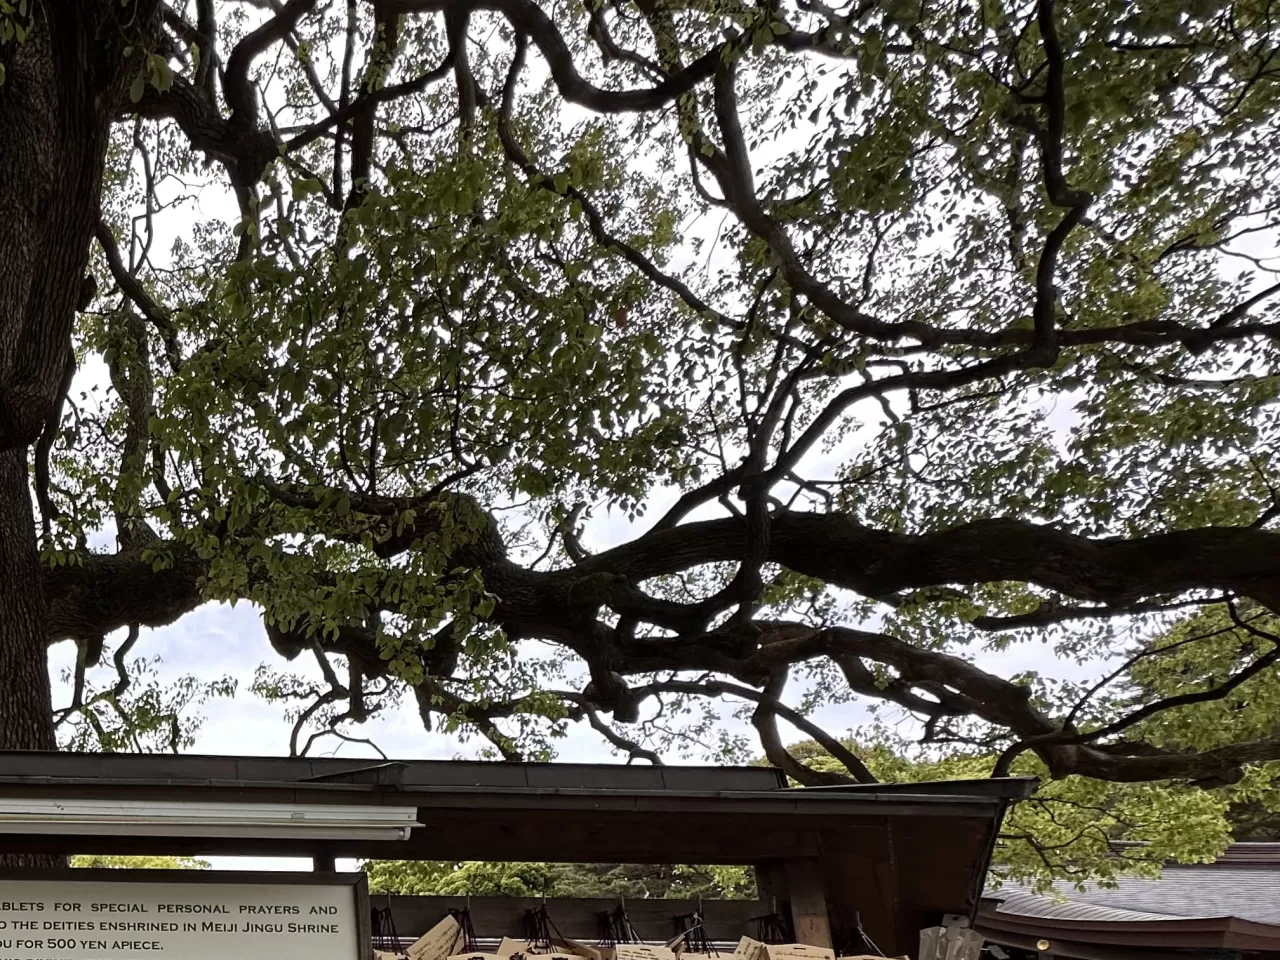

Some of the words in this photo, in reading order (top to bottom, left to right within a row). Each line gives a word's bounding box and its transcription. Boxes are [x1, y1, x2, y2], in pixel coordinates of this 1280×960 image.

[54, 902, 82, 912] FOR
[91, 903, 149, 913] SPECIAL
[157, 904, 230, 914] PERSONAL
[239, 905, 300, 915] PRAYERS
[309, 905, 338, 915] AND
[11, 920, 39, 930] THE
[43, 921, 95, 931] DEITIES
[99, 921, 179, 932] ENSHRINED
[183, 922, 197, 932] IN
[201, 921, 238, 933] MEIJI
[241, 921, 283, 933] JINGU
[287, 922, 339, 934] SHRINE
[16, 939, 44, 949] FOR
[47, 938, 77, 950] 500
[79, 940, 107, 950] YEN
[111, 940, 164, 951] APIECE.
